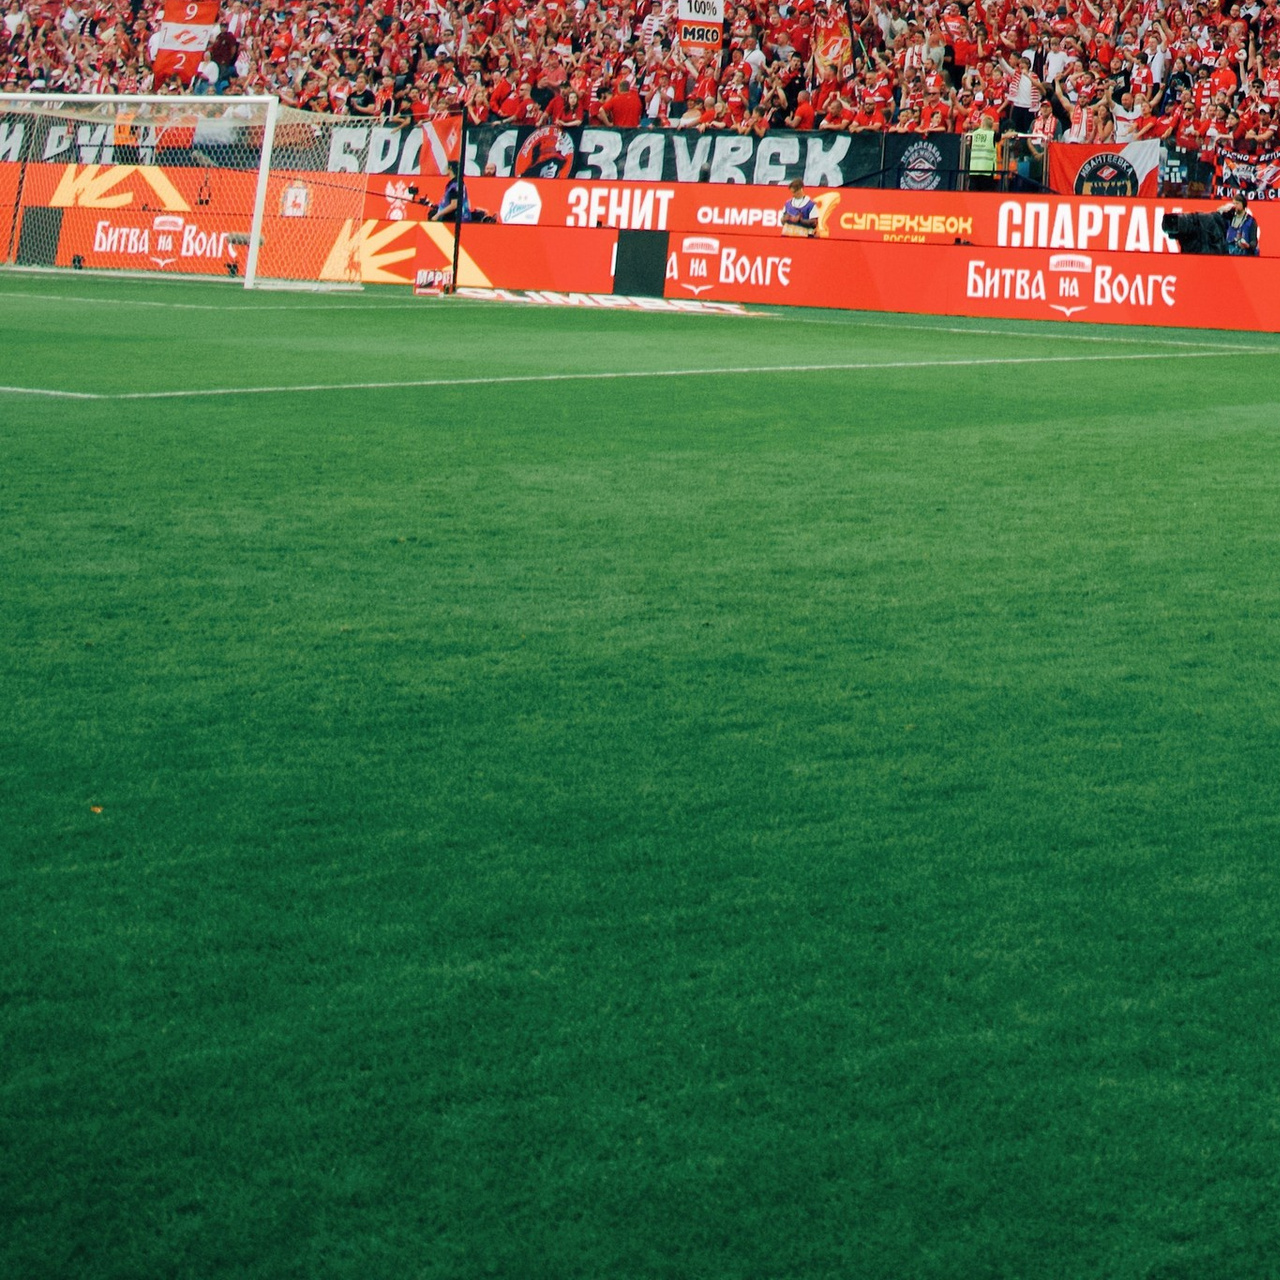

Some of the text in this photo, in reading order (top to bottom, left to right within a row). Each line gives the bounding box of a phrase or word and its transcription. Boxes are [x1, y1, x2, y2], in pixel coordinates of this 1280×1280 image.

[185, 3, 198, 20] 9
[682, 26, 719, 42] МЯСО
[173, 53, 187, 69] 2
[1080, 155, 1133, 178] ИВАНТЕЕВКА
[566, 187, 675, 230] ЗЕНИТ
[697, 206, 783, 227] OLIMPB
[840, 212, 973, 234] СУПЕРКУБОК
